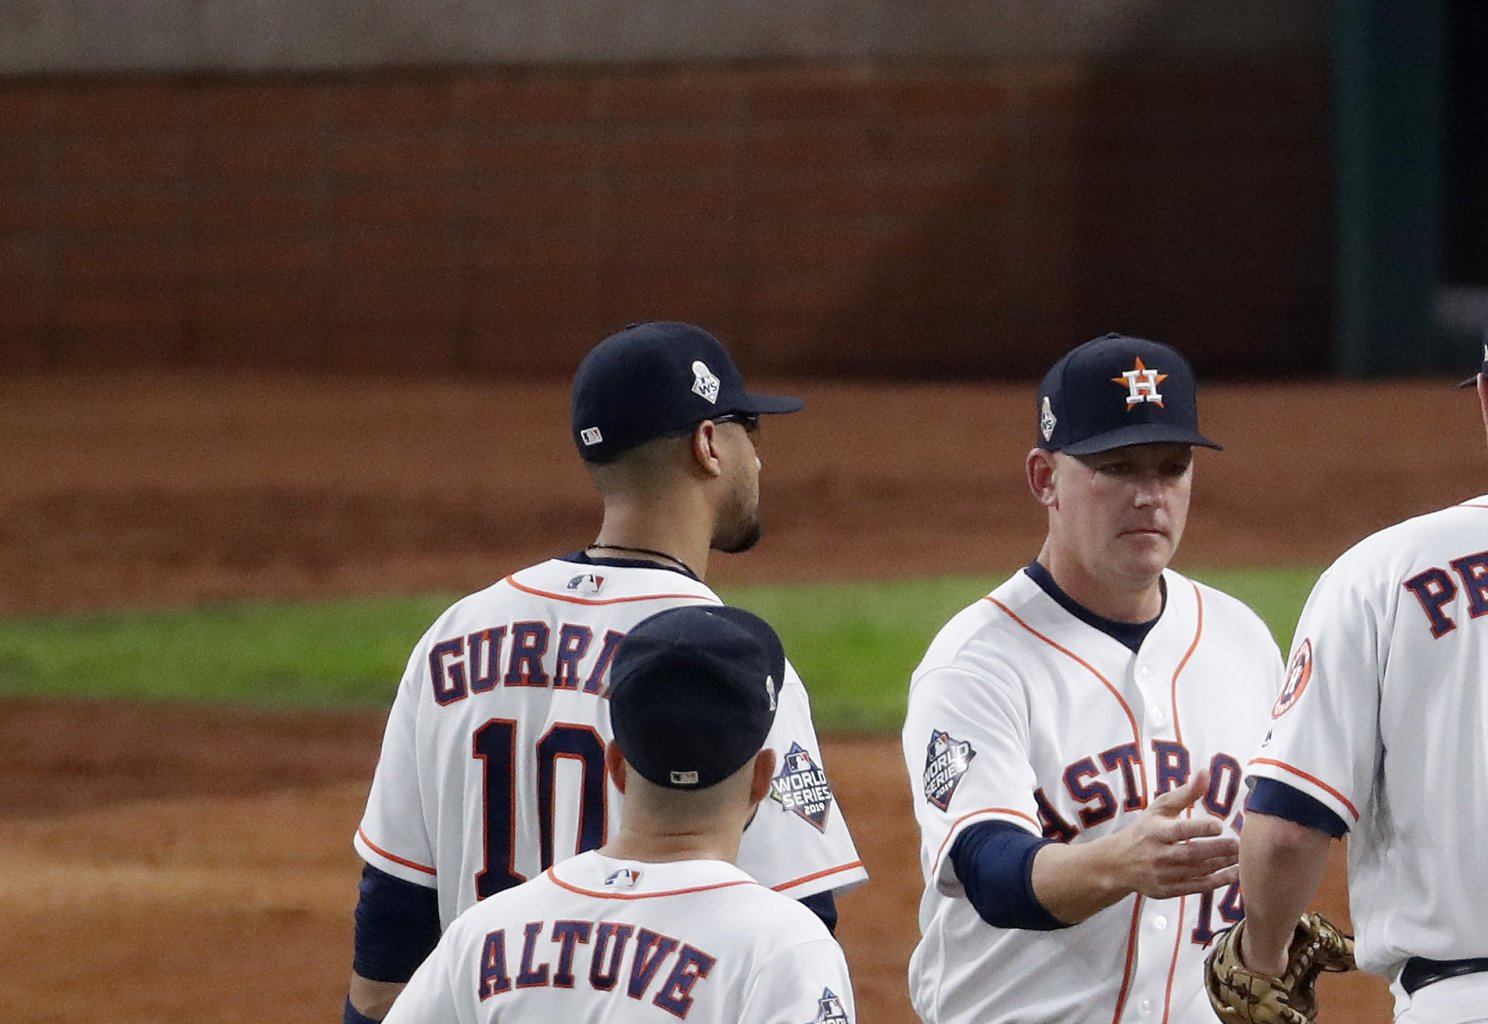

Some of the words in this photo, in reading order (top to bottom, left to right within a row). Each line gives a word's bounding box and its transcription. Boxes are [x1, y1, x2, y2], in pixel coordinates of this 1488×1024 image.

[1122, 369, 1163, 404] H
[429, 620, 627, 706] GURRI
[472, 717, 609, 900] 10
[772, 770, 827, 792] WORLD
[782, 786, 831, 808] SERIES
[804, 803, 825, 815] 2019
[1034, 738, 1243, 844] ASTRO
[477, 920, 716, 1019] ALTUVE
